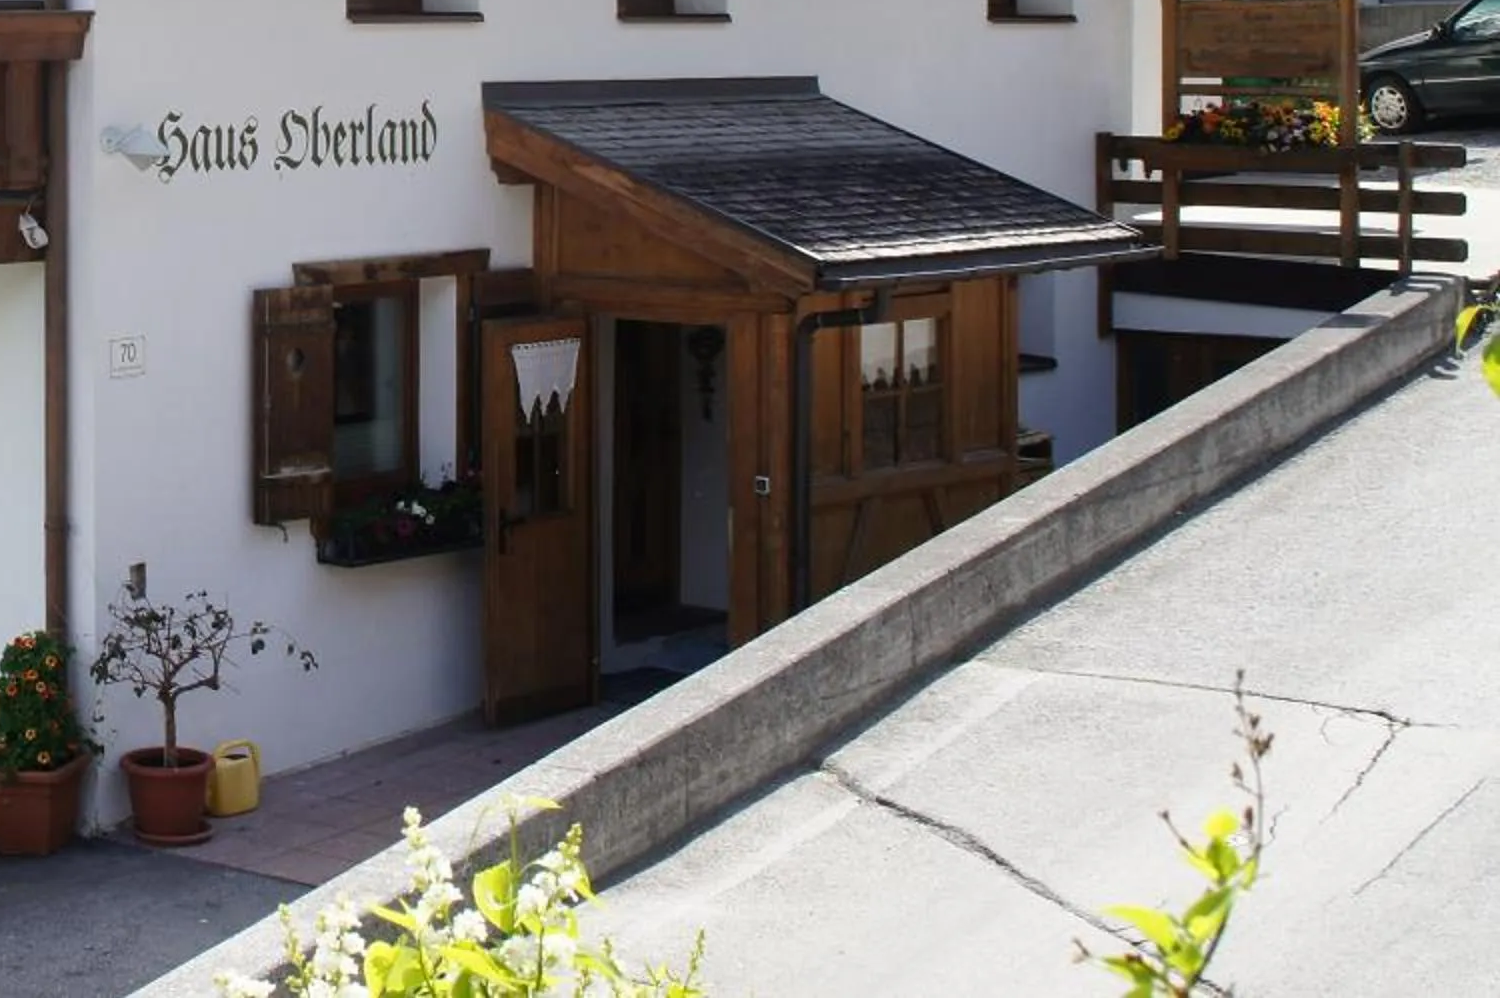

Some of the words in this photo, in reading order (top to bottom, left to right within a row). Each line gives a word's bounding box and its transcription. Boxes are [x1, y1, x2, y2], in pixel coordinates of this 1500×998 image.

[155, 111, 259, 184] Haus
[273, 99, 438, 171] Oberland
[119, 342, 137, 363] 70
